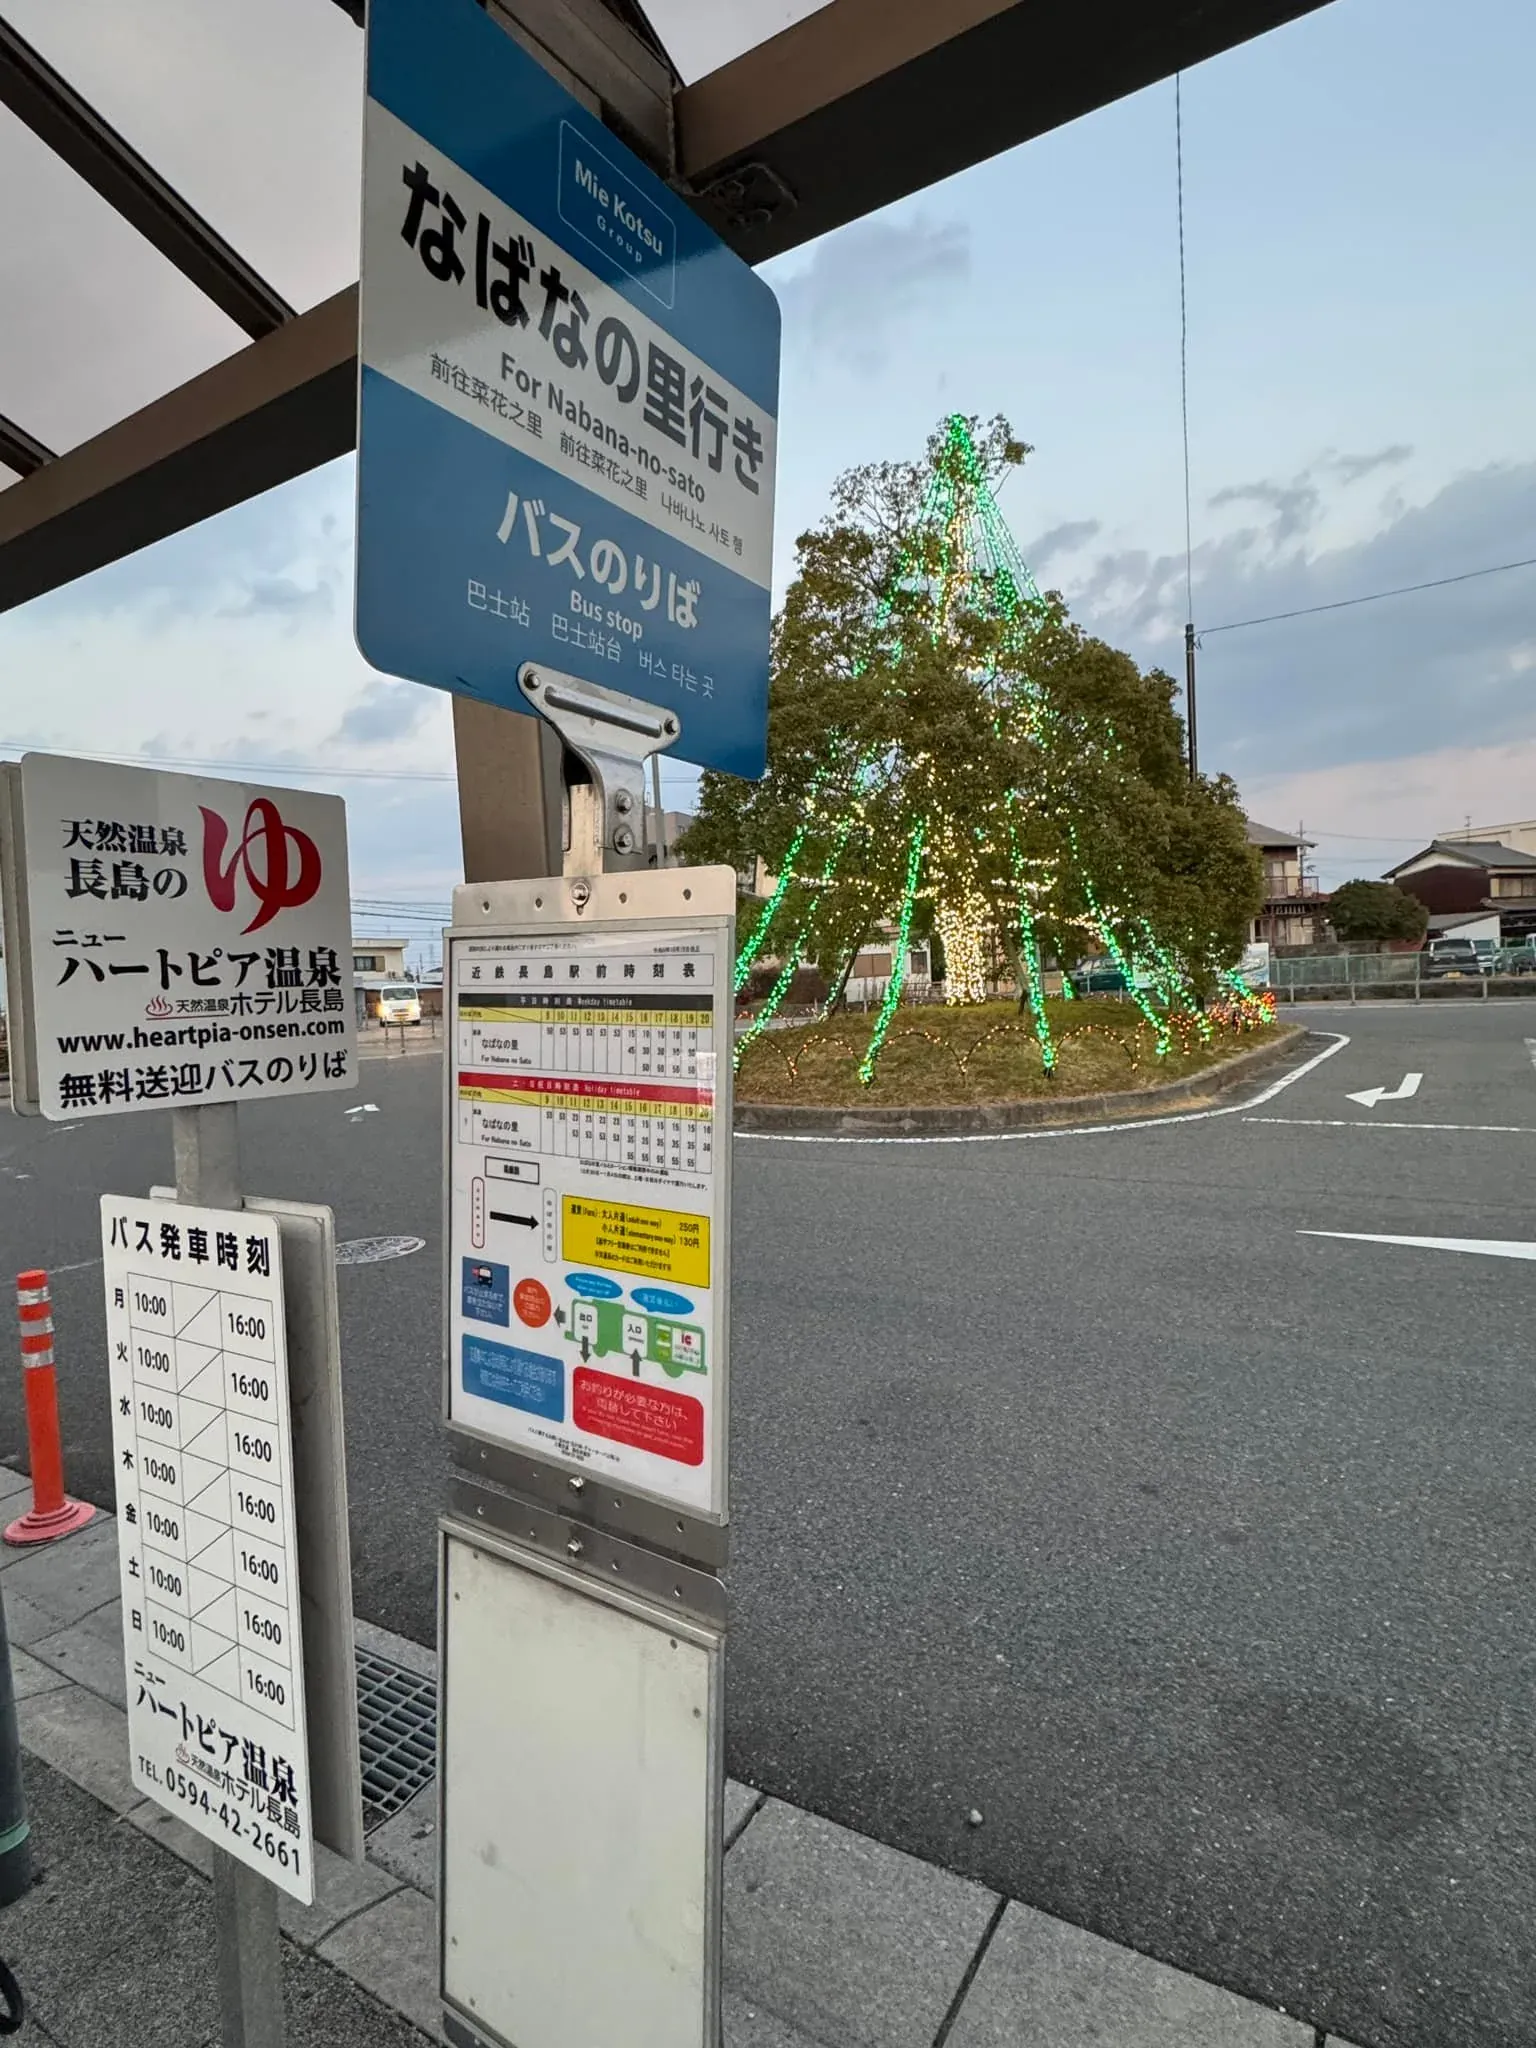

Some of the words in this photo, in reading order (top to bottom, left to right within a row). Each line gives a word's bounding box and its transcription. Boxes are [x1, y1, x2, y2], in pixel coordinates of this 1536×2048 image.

[575, 159, 609, 208] Mie
[613, 195, 664, 257] Kotsu
[596, 214, 644, 263] Group
[400, 160, 764, 495] なばなの里行き
[429, 353, 543, 439] 前往菜花之里
[560, 431, 649, 501] 前往菜花之里
[501, 352, 539, 399] For
[548, 387, 706, 503] Nabana-no-sato
[496, 491, 701, 629] バスのりば
[708, 522, 730, 549] 사토
[467, 578, 531, 628] 巴士站
[551, 613, 622, 663] 巴士站台
[570, 590, 602, 622] Bus
[606, 605, 643, 642] stop
[639, 650, 667, 682] 버스
[671, 660, 697, 691] 타는
[61, 819, 188, 857] 天然温泉
[64, 858, 187, 901] 長島の
[197, 798, 322, 935] ゆ
[52, 929, 126, 947] ニュー
[57, 946, 342, 990] ハートピア温泉
[230, 987, 345, 1016] ホテル長島
[570, 1011, 577, 1020] 11
[584, 1011, 592, 1021] 12
[611, 1013, 619, 1021] 14
[626, 1013, 634, 1022] 15
[655, 1013, 663, 1022] 17
[670, 1013, 679, 1023] 18
[685, 1014, 694, 1023] 19
[700, 1014, 710, 1024] 20
[57, 1017, 345, 1053] www.heartpia-onsen.com
[482, 1038, 519, 1050] なばなの里
[628, 1030, 636, 1038] 15
[58, 1049, 348, 1109] 無料送迎バスのりば
[482, 1118, 519, 1132] なばなの里
[570, 1097, 578, 1106] 11
[583, 1098, 591, 1107] 12
[654, 1104, 662, 1114] 17
[669, 1105, 677, 1115] 18
[685, 1106, 693, 1116] 19
[688, 1124, 695, 1133] 15
[110, 1216, 271, 1277] バス発車時刻
[114, 1287, 125, 1309] 月
[135, 1292, 167, 1317] 10:00
[228, 1313, 265, 1340] 16:00
[627, 1323, 642, 1334] 入口
[681, 1333, 692, 1346] IC
[116, 1342, 128, 1363] 火
[137, 1347, 169, 1373] 10:00
[231, 1372, 268, 1401] 16:00
[119, 1396, 131, 1417] 水
[140, 1402, 173, 1429] 10:00
[234, 1432, 272, 1463] 16:00
[122, 1449, 134, 1470] 木
[144, 1456, 176, 1485] 10:00
[238, 1491, 275, 1523] 16:00
[125, 1503, 137, 1526] 金
[146, 1511, 178, 1541] 10:00
[241, 1550, 279, 1584] 16:00
[128, 1556, 140, 1578] 土
[149, 1565, 182, 1597] 10:00
[244, 1610, 282, 1646] 16:00
[131, 1609, 142, 1632] 日
[153, 1620, 185, 1652] 10:00
[247, 1669, 285, 1706] 16:00
[134, 1661, 166, 1686] ニュー
[136, 1684, 298, 1807] ハートピア温泉
[138, 1756, 163, 1786] TEL.
[166, 1770, 301, 1876] 0594-42-2661
[221, 1771, 301, 1840] ホテル長島
